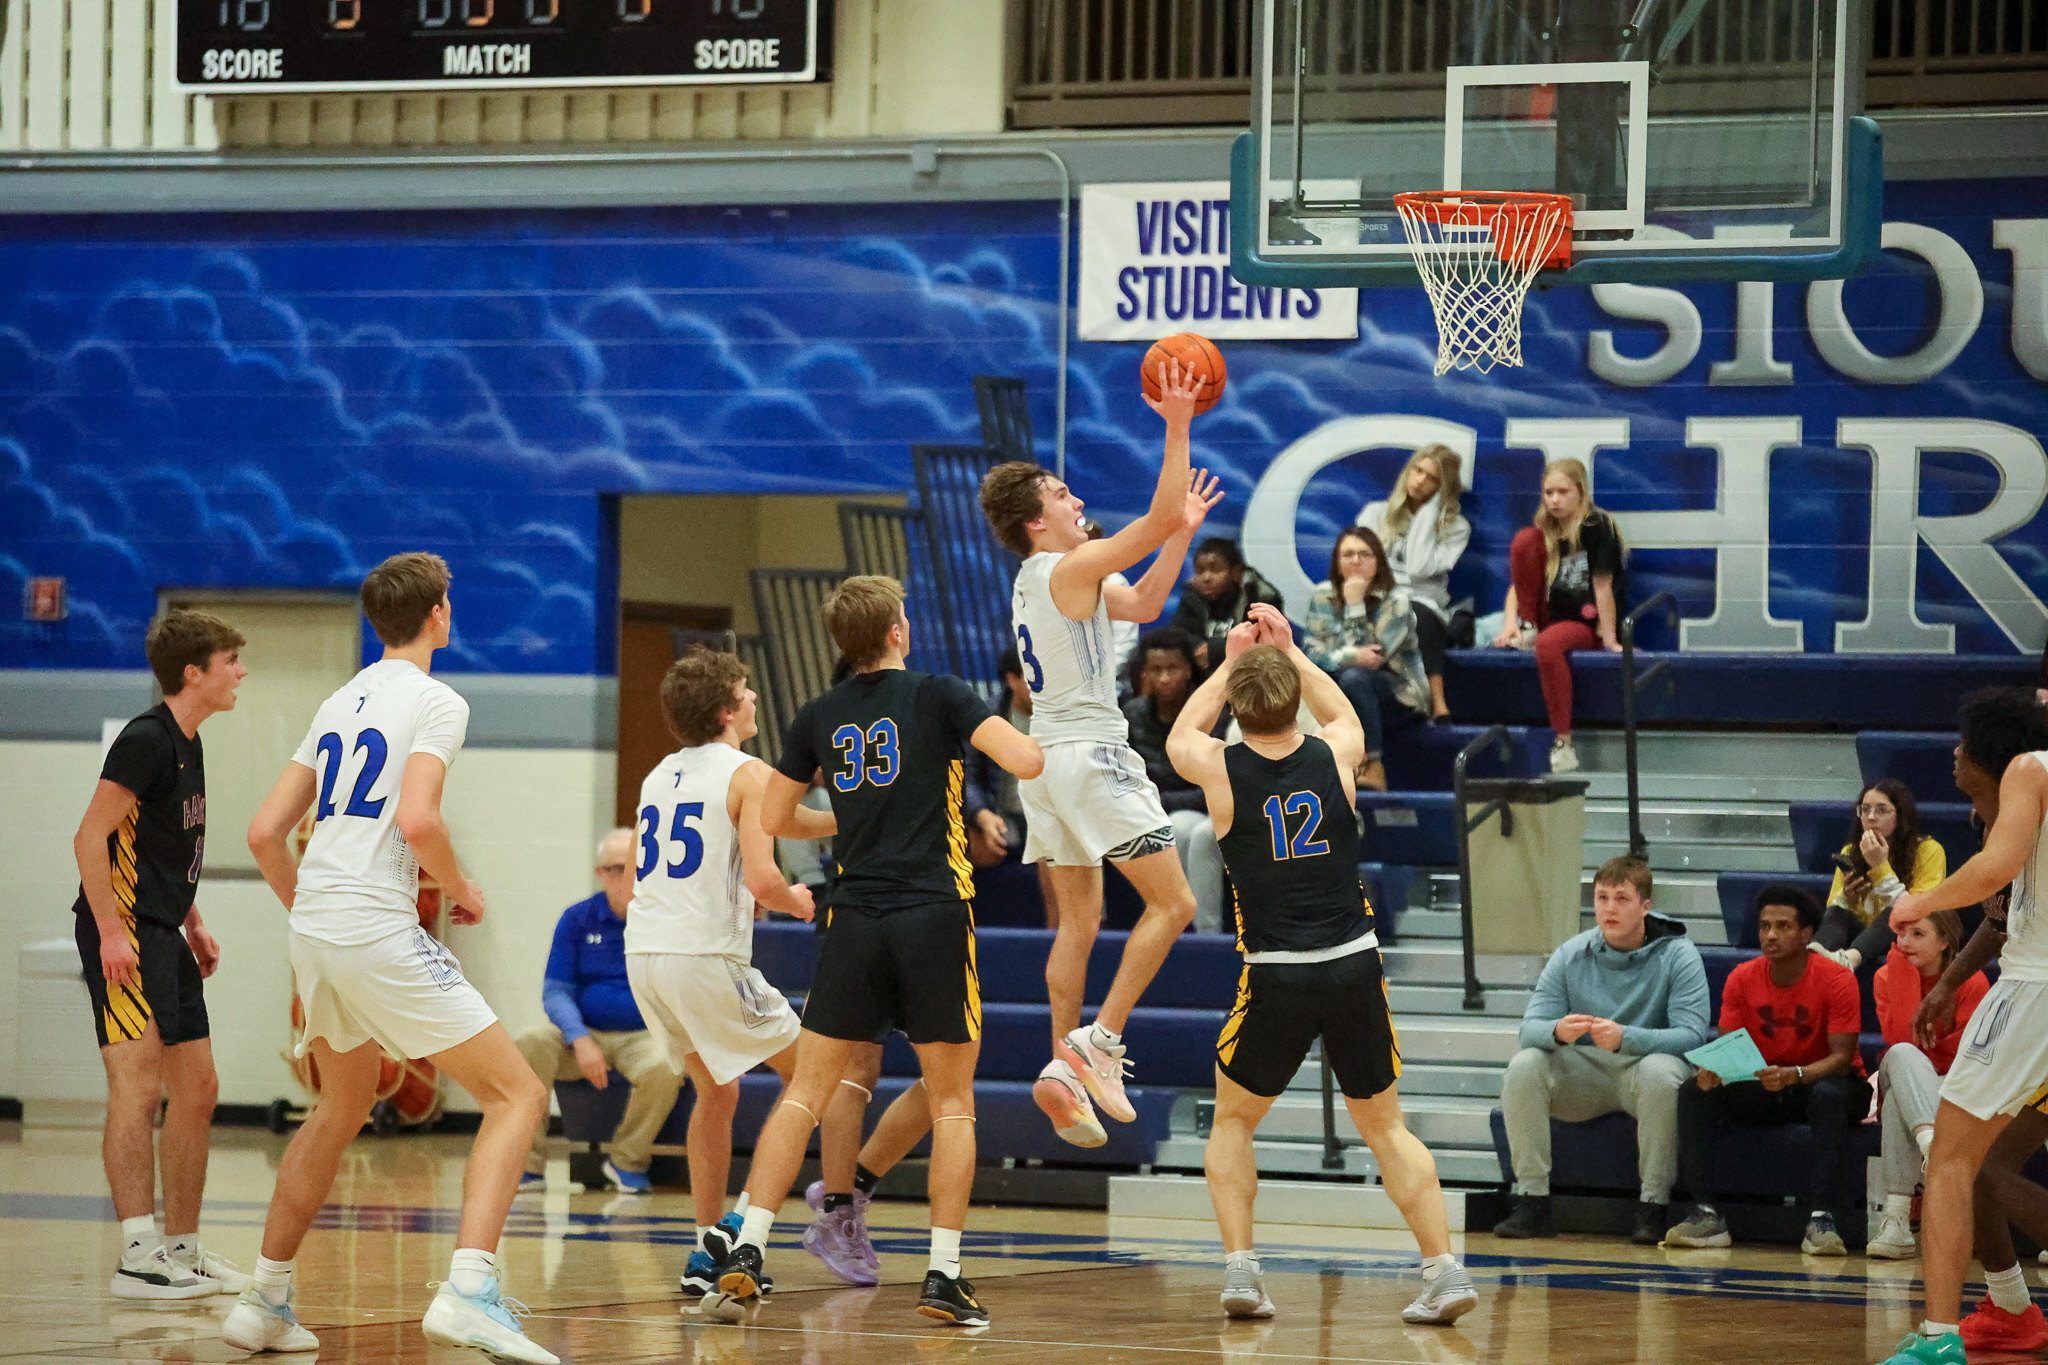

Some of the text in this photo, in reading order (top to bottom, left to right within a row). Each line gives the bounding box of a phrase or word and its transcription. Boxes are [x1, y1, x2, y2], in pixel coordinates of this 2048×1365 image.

[202, 48, 283, 80] SCORE
[443, 43, 531, 75] MATCH
[695, 38, 780, 70] SCORE
[1588, 218, 2048, 387] SIO
[1018, 624, 1044, 693] 3
[316, 728, 388, 822] 22
[832, 717, 900, 793] 33
[636, 802, 704, 882] 35
[1263, 789, 1331, 861] 12
